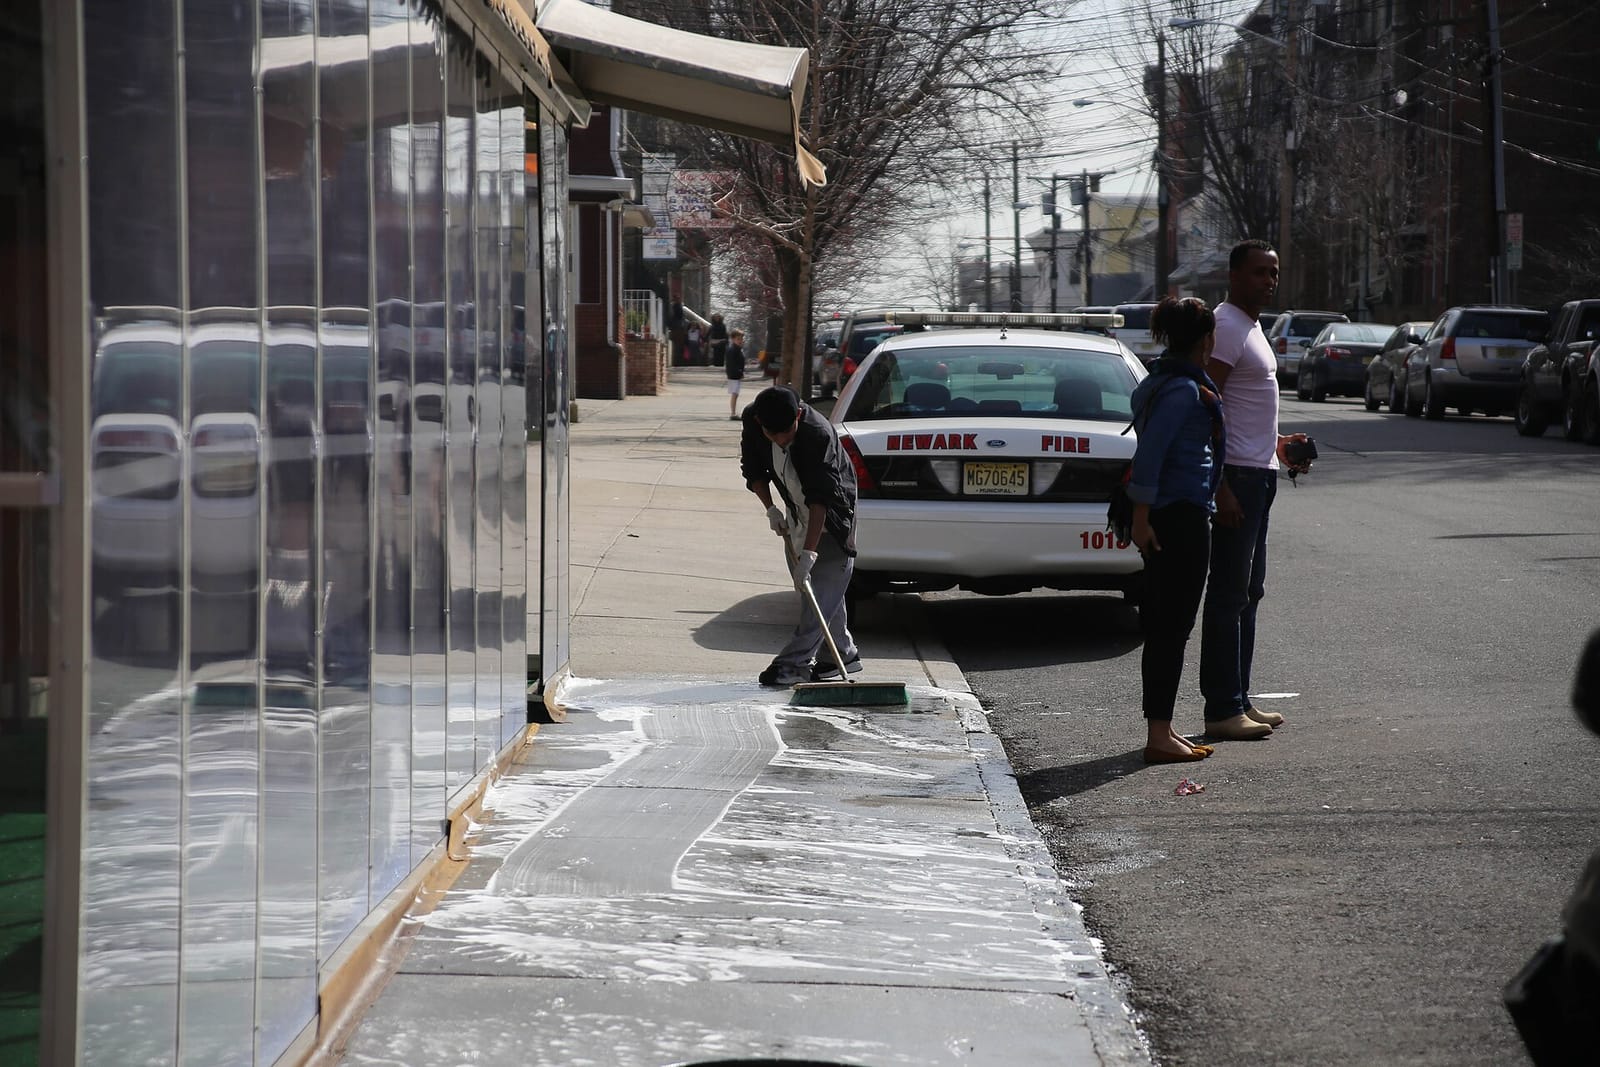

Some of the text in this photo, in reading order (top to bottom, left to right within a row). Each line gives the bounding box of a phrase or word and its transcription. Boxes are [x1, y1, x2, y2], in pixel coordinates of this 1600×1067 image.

[887, 433, 978, 450] NEWARK
[1041, 435, 1090, 454] FIRE
[967, 470, 1025, 487] MG70645
